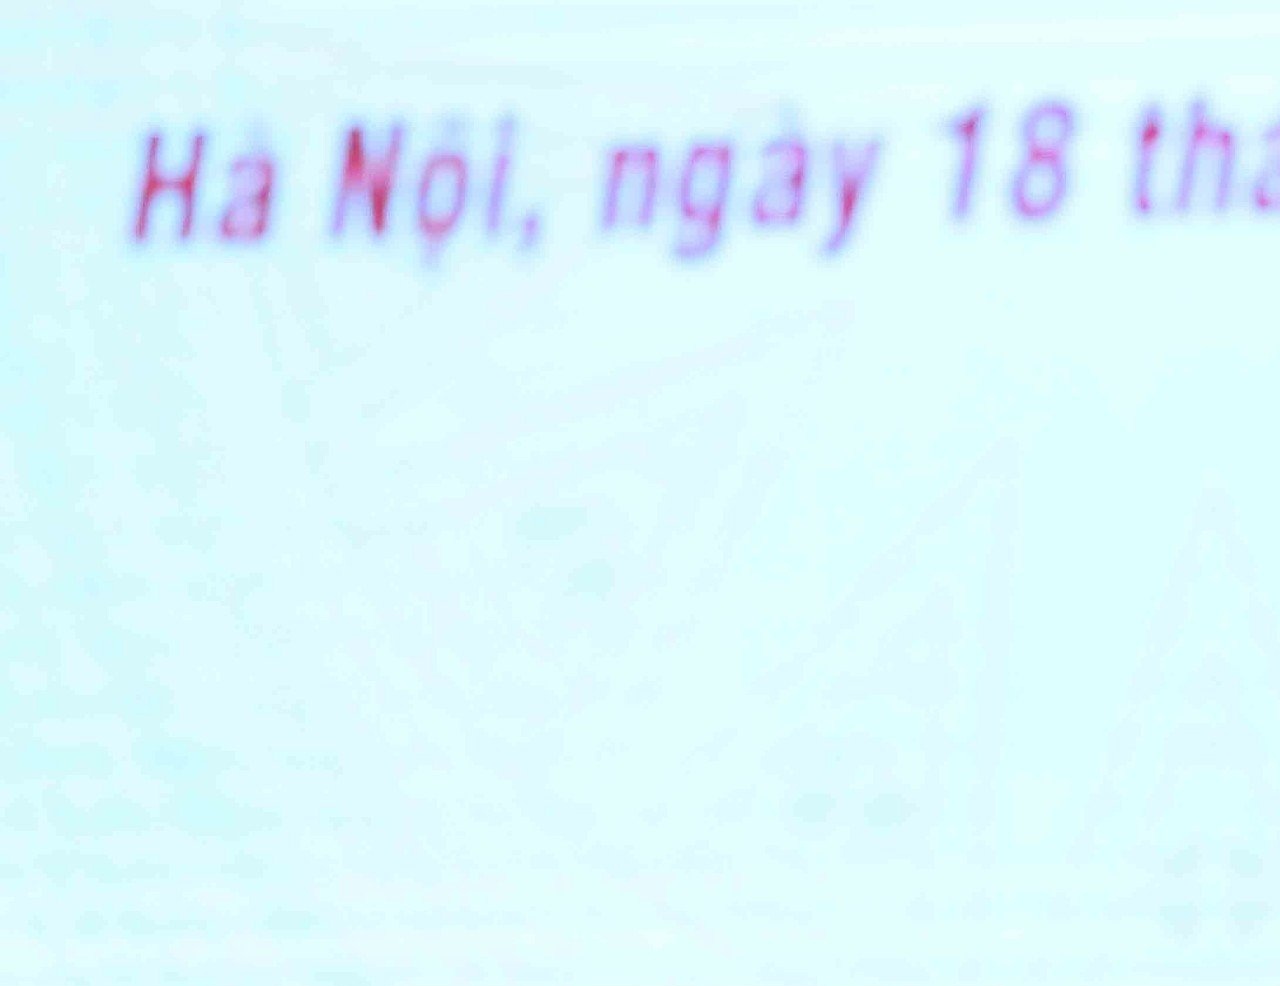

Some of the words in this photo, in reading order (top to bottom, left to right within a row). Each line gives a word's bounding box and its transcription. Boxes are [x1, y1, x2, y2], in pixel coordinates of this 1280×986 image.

[131, 118, 278, 243] Hà
[601, 106, 880, 258] ngày
[950, 98, 1076, 220] 18
